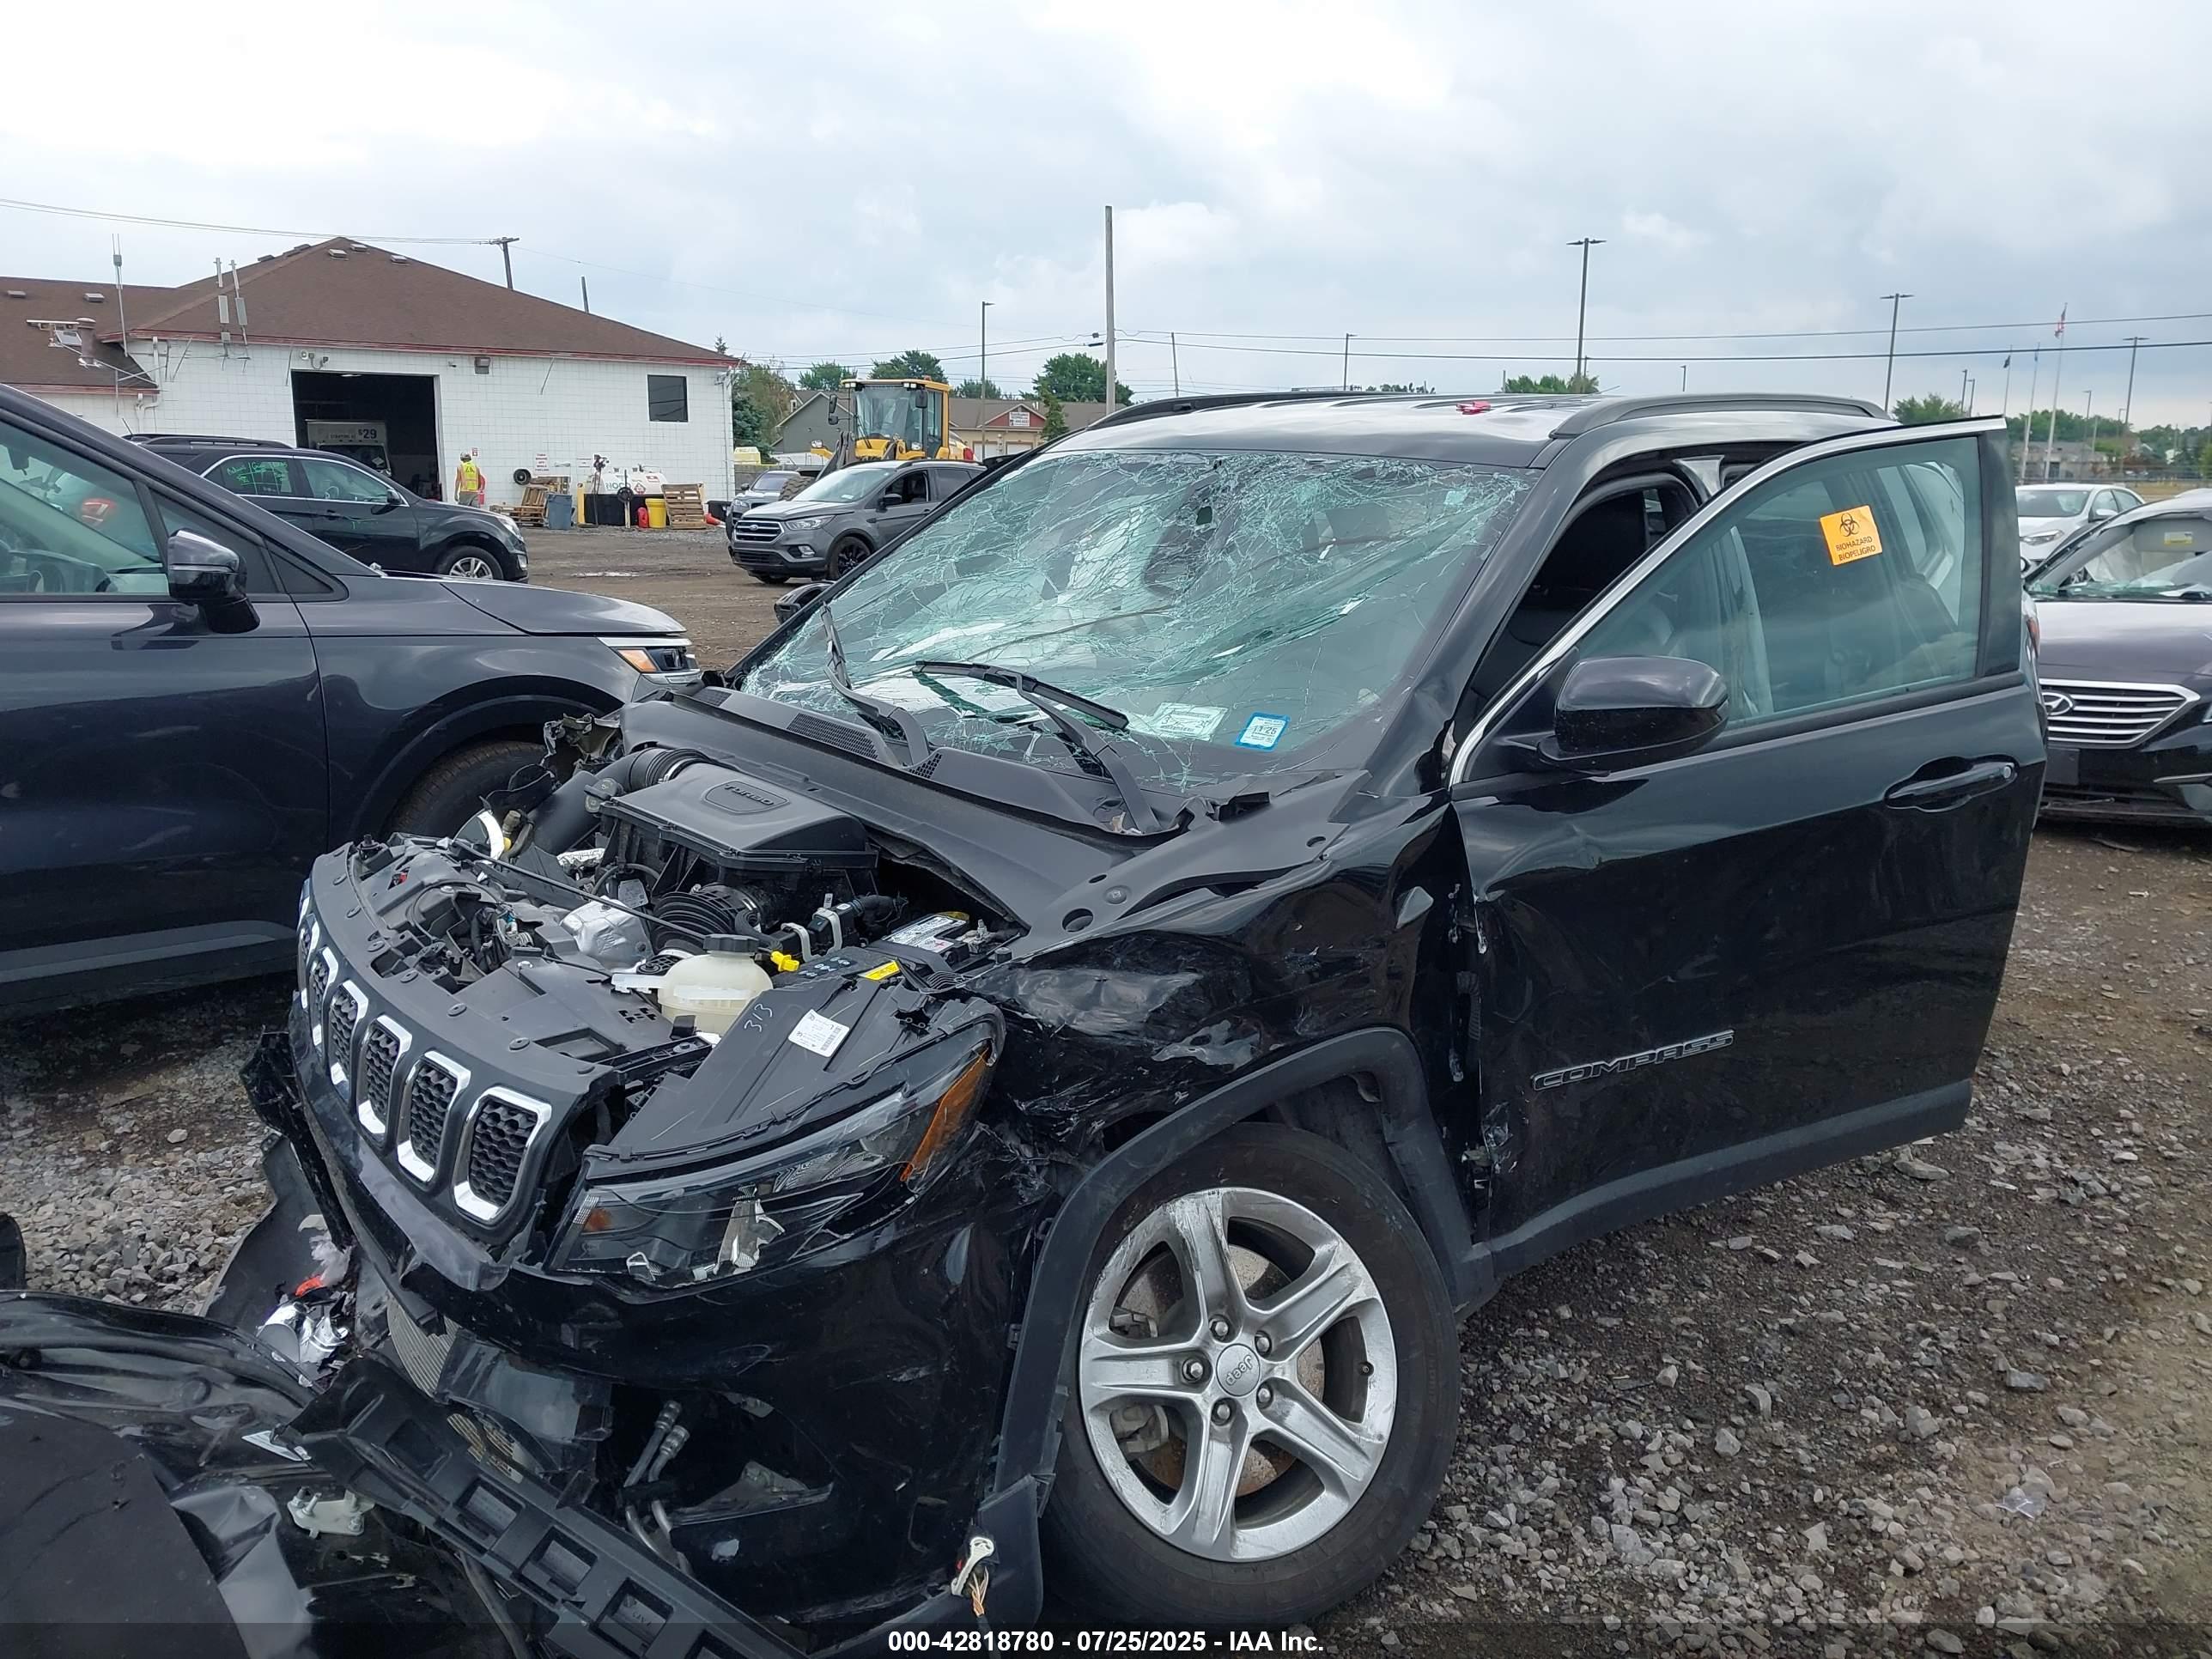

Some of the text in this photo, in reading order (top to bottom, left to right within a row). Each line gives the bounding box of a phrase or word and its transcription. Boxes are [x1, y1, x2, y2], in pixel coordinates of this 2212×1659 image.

[1835, 536, 1873, 552] BIOHAZARD
[1838, 545, 1876, 562] BIOPELIGRO
[724, 784, 775, 806] TURBO
[744, 1003, 773, 1032] 313
[1530, 1029, 1735, 1091] COMPASS
[1224, 1354, 1255, 1387] Jeep
